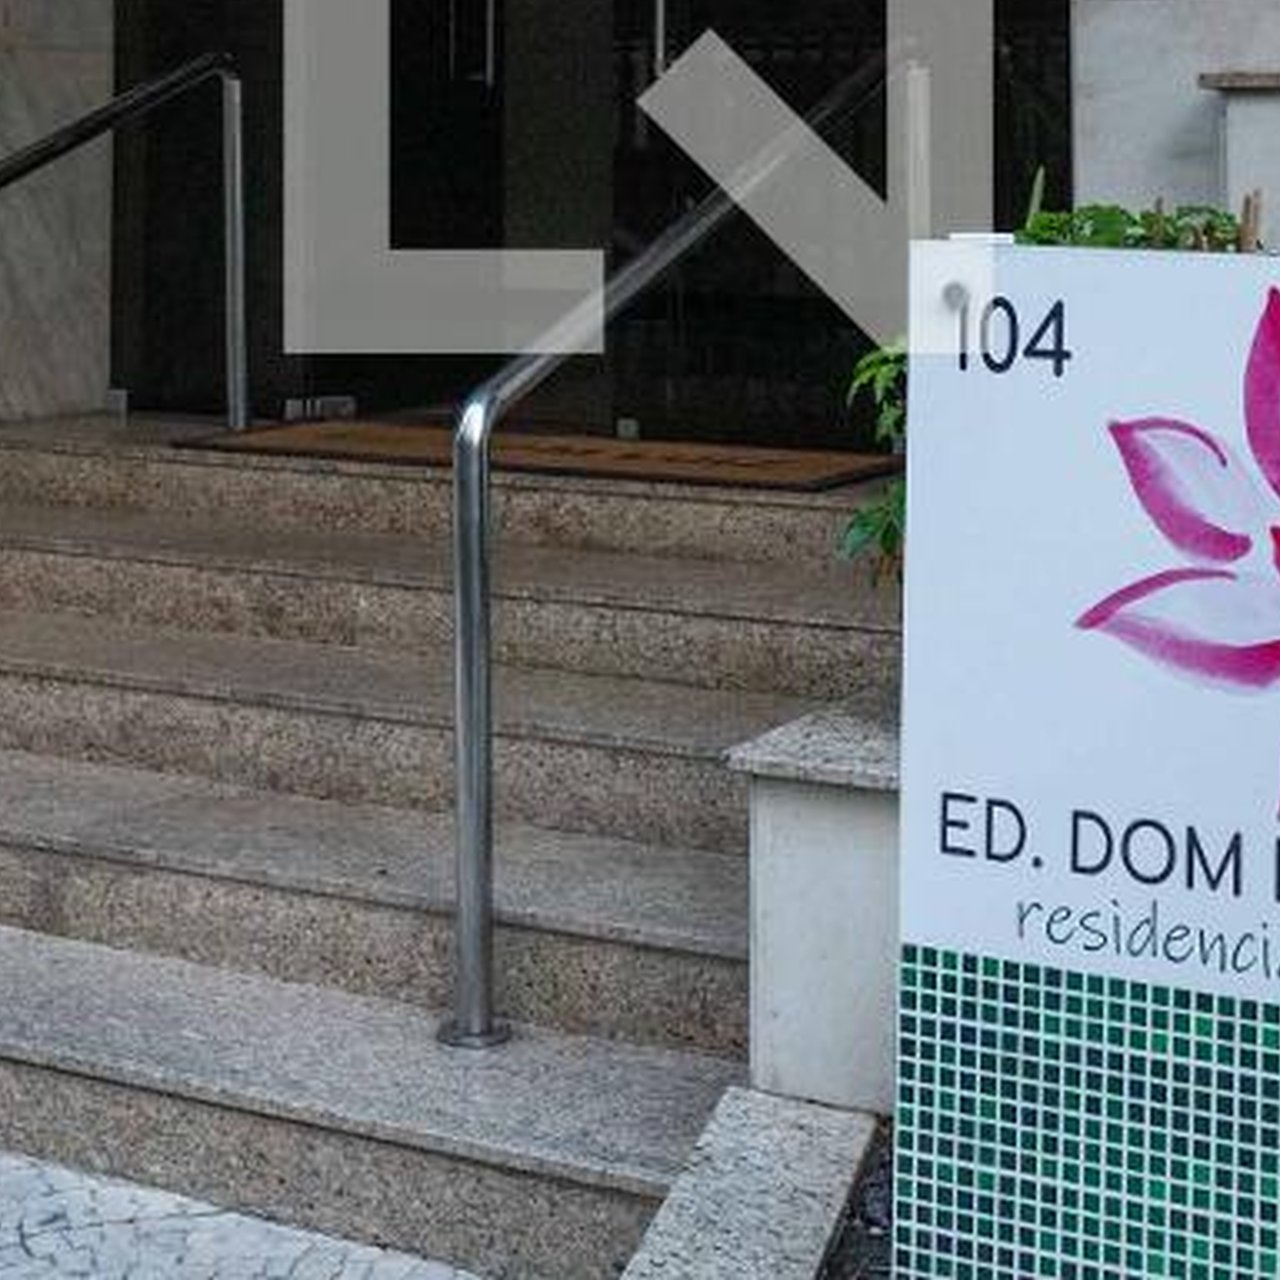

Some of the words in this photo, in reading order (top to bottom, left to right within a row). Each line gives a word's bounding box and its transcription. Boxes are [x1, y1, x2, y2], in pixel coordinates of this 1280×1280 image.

[952, 294, 1072, 378] 104
[939, 791, 1044, 869] ED.
[1071, 809, 1242, 899] DOM
